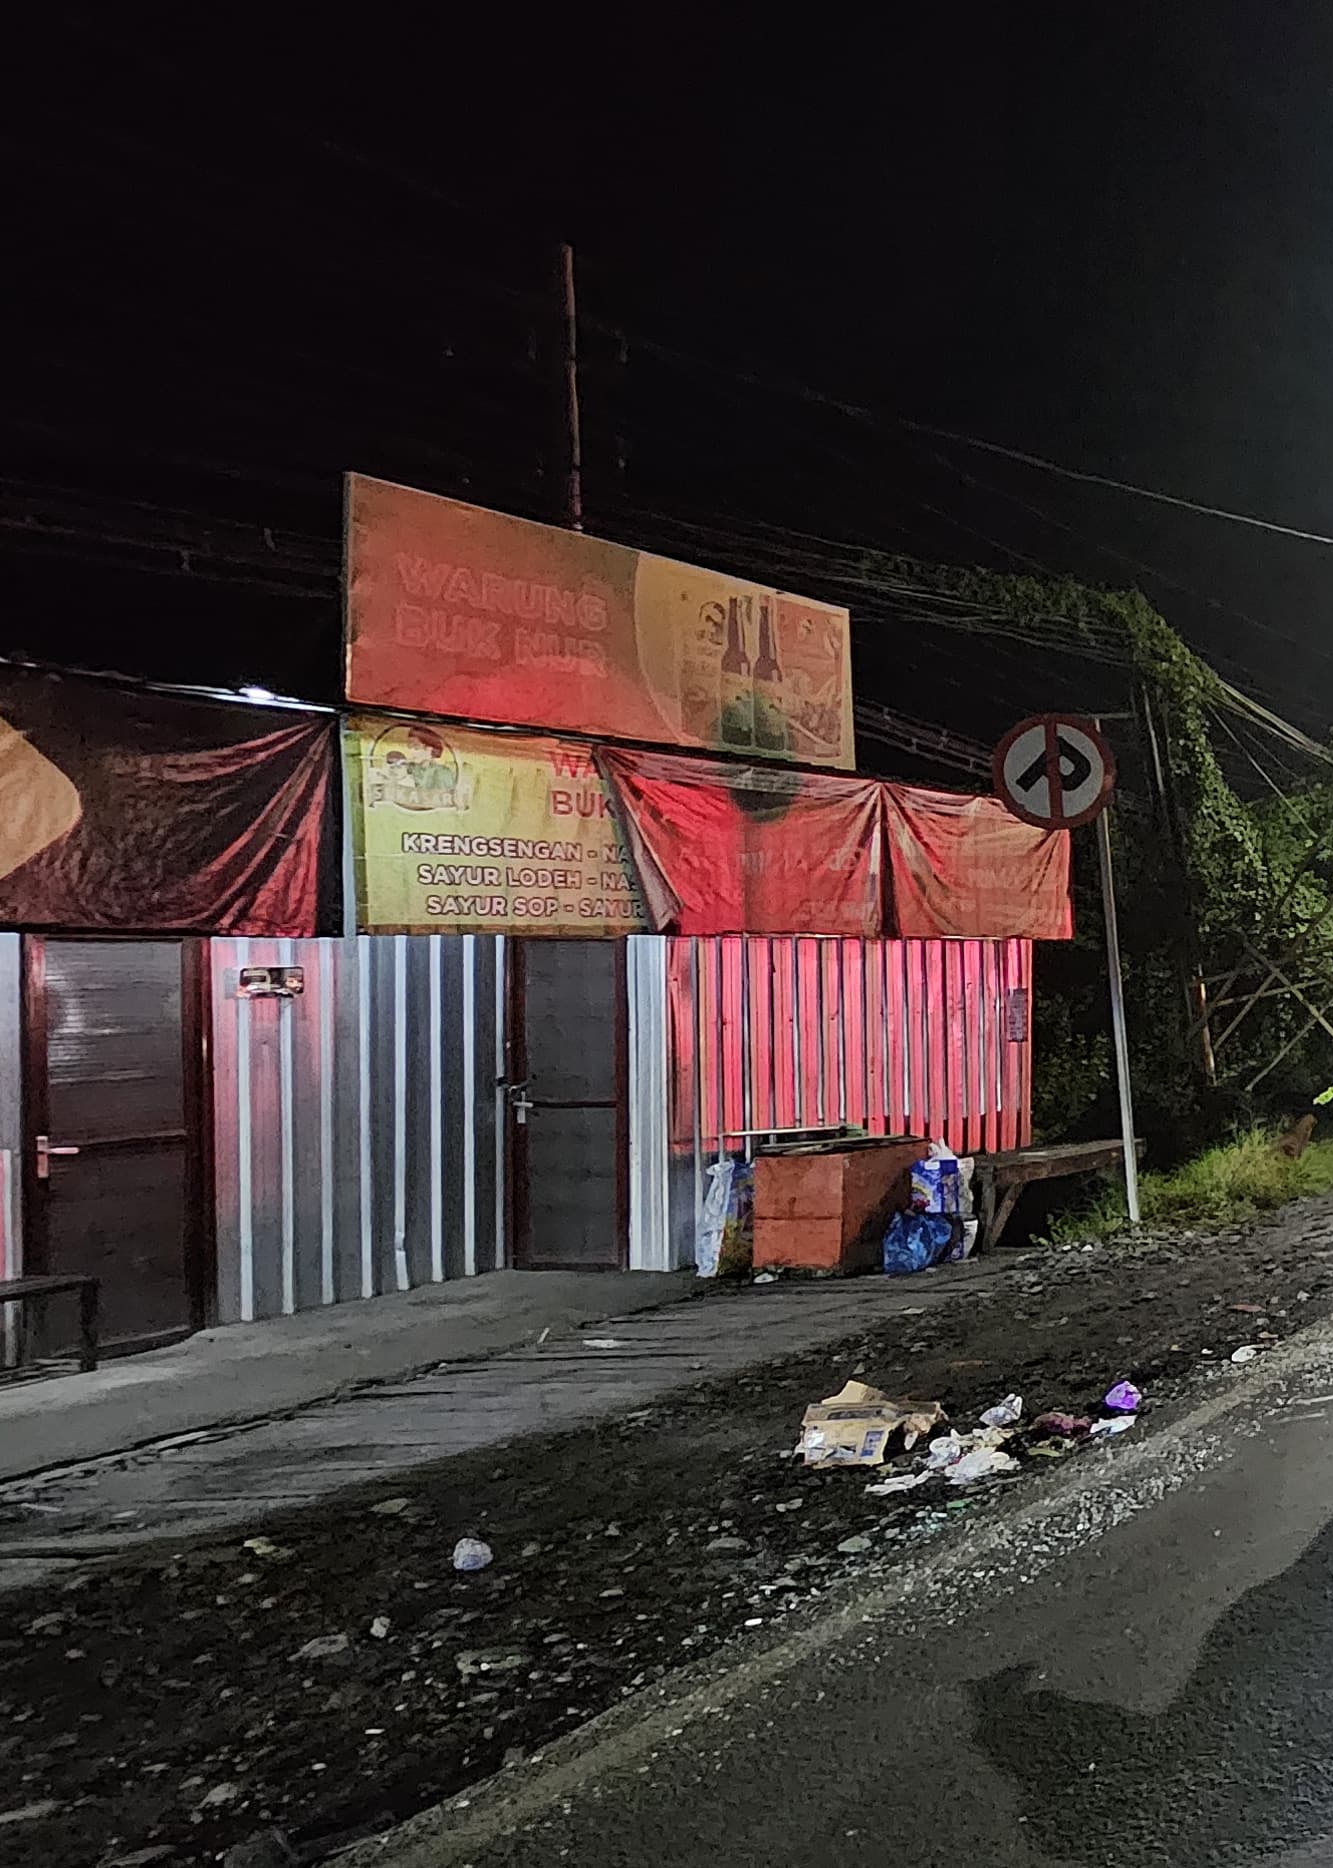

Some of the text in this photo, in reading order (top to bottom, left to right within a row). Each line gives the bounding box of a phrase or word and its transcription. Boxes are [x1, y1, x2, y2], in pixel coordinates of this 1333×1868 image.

[396, 552, 608, 632] WARUNG
[402, 832, 582, 861] KRENGSENGAN
[417, 864, 500, 886] SAYUR
[506, 867, 582, 889] LODEH
[427, 894, 507, 916] SAYUR
[513, 897, 558, 916] SOP
[579, 898, 645, 918] SAYUR
